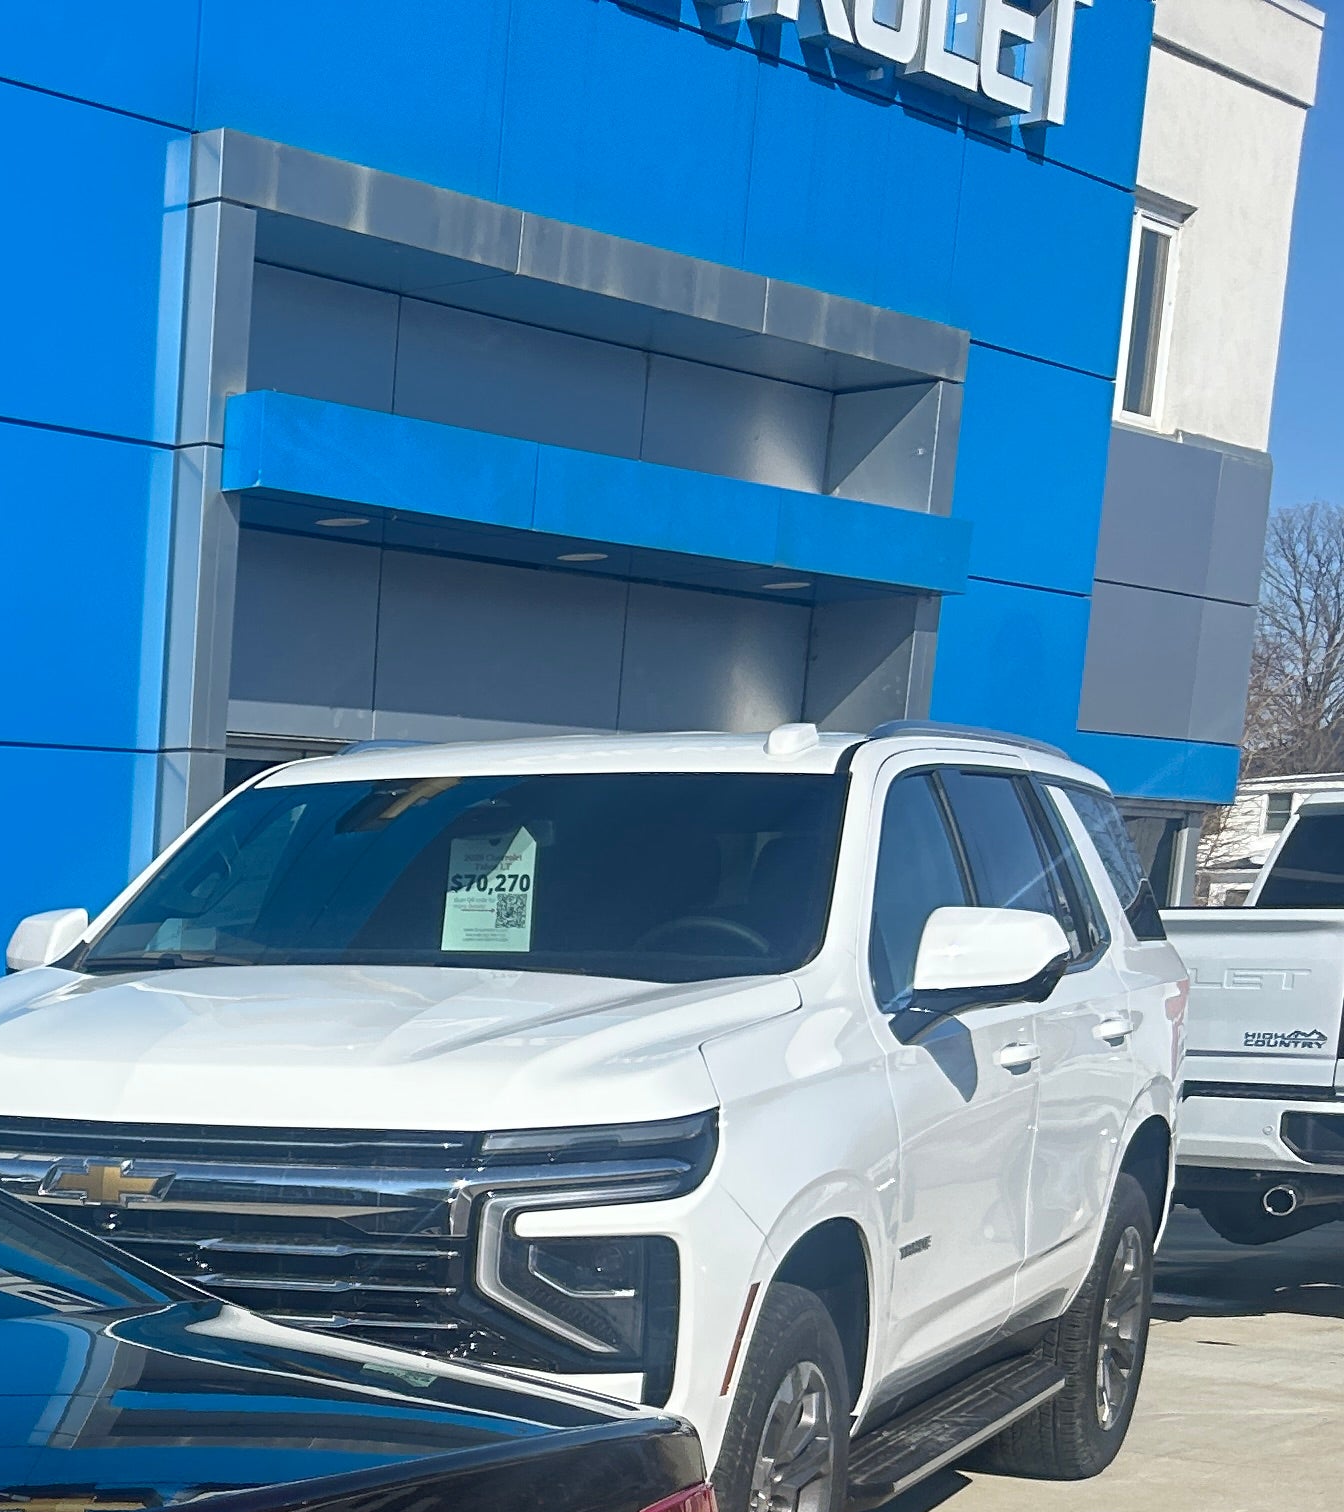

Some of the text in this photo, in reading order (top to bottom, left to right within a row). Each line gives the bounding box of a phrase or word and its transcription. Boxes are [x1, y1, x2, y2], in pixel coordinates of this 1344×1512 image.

[450, 873, 531, 895] $70,270
[1244, 1031, 1285, 1041] HIGH
[1243, 1039, 1327, 1049] COUNTRY
